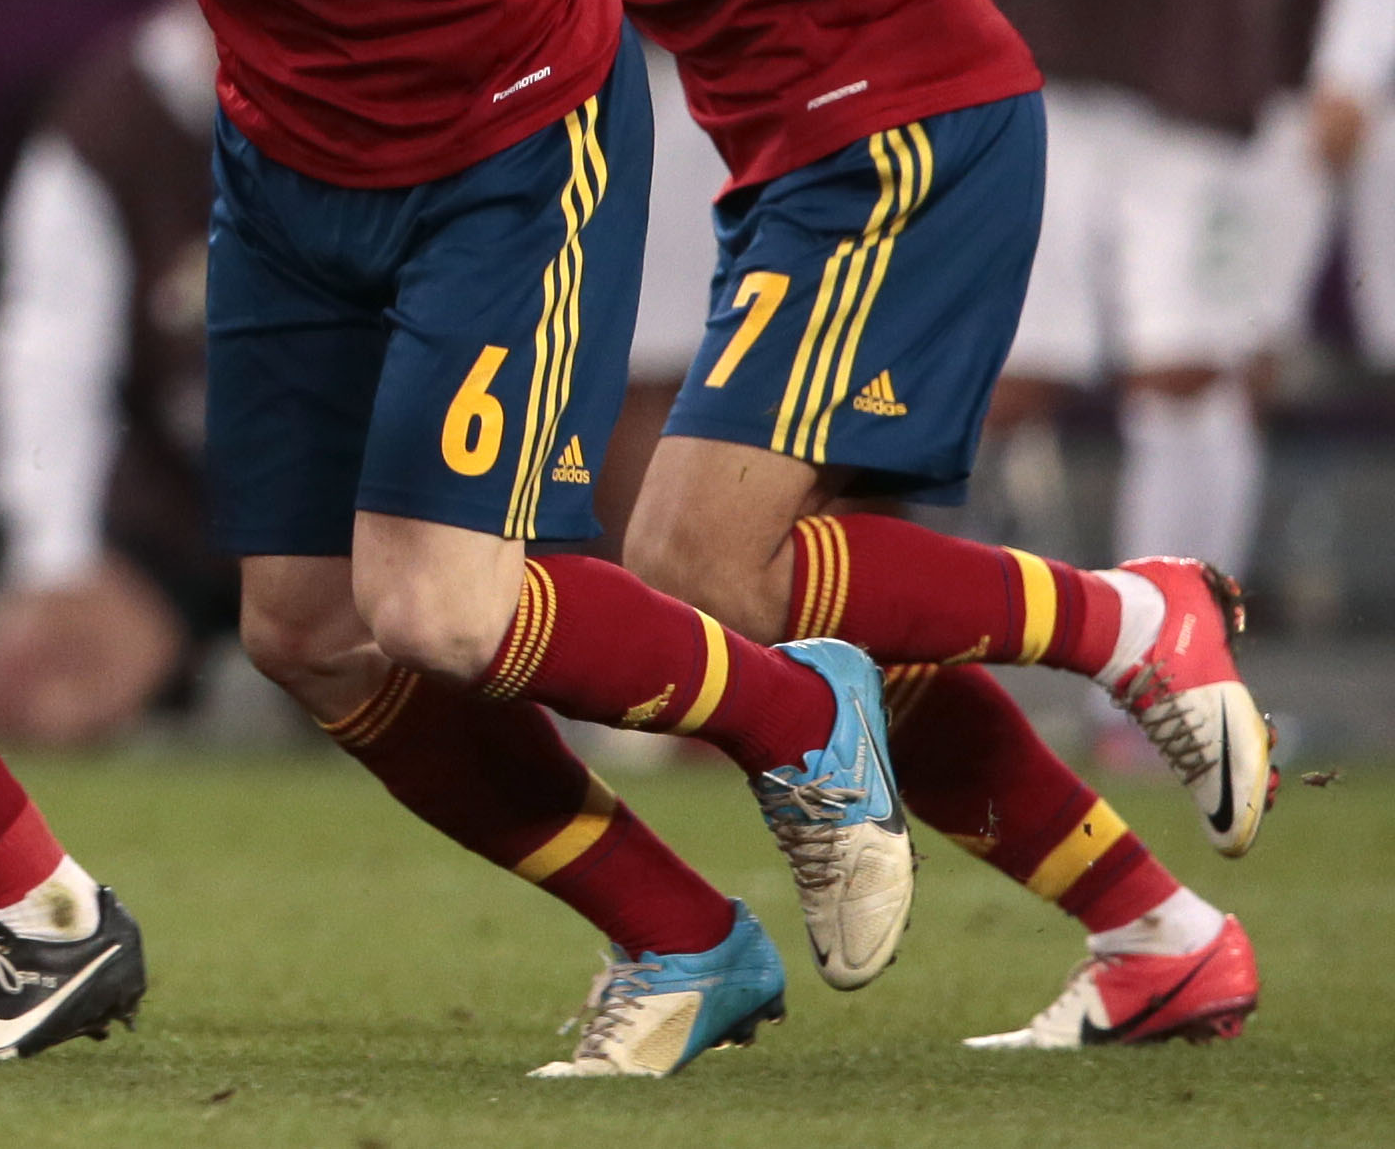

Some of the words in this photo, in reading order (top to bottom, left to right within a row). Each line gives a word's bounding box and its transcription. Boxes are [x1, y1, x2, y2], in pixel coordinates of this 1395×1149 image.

[704, 270, 791, 388] 7
[441, 344, 509, 477] 6
[853, 395, 908, 417] adidas
[551, 466, 591, 485] adidas
